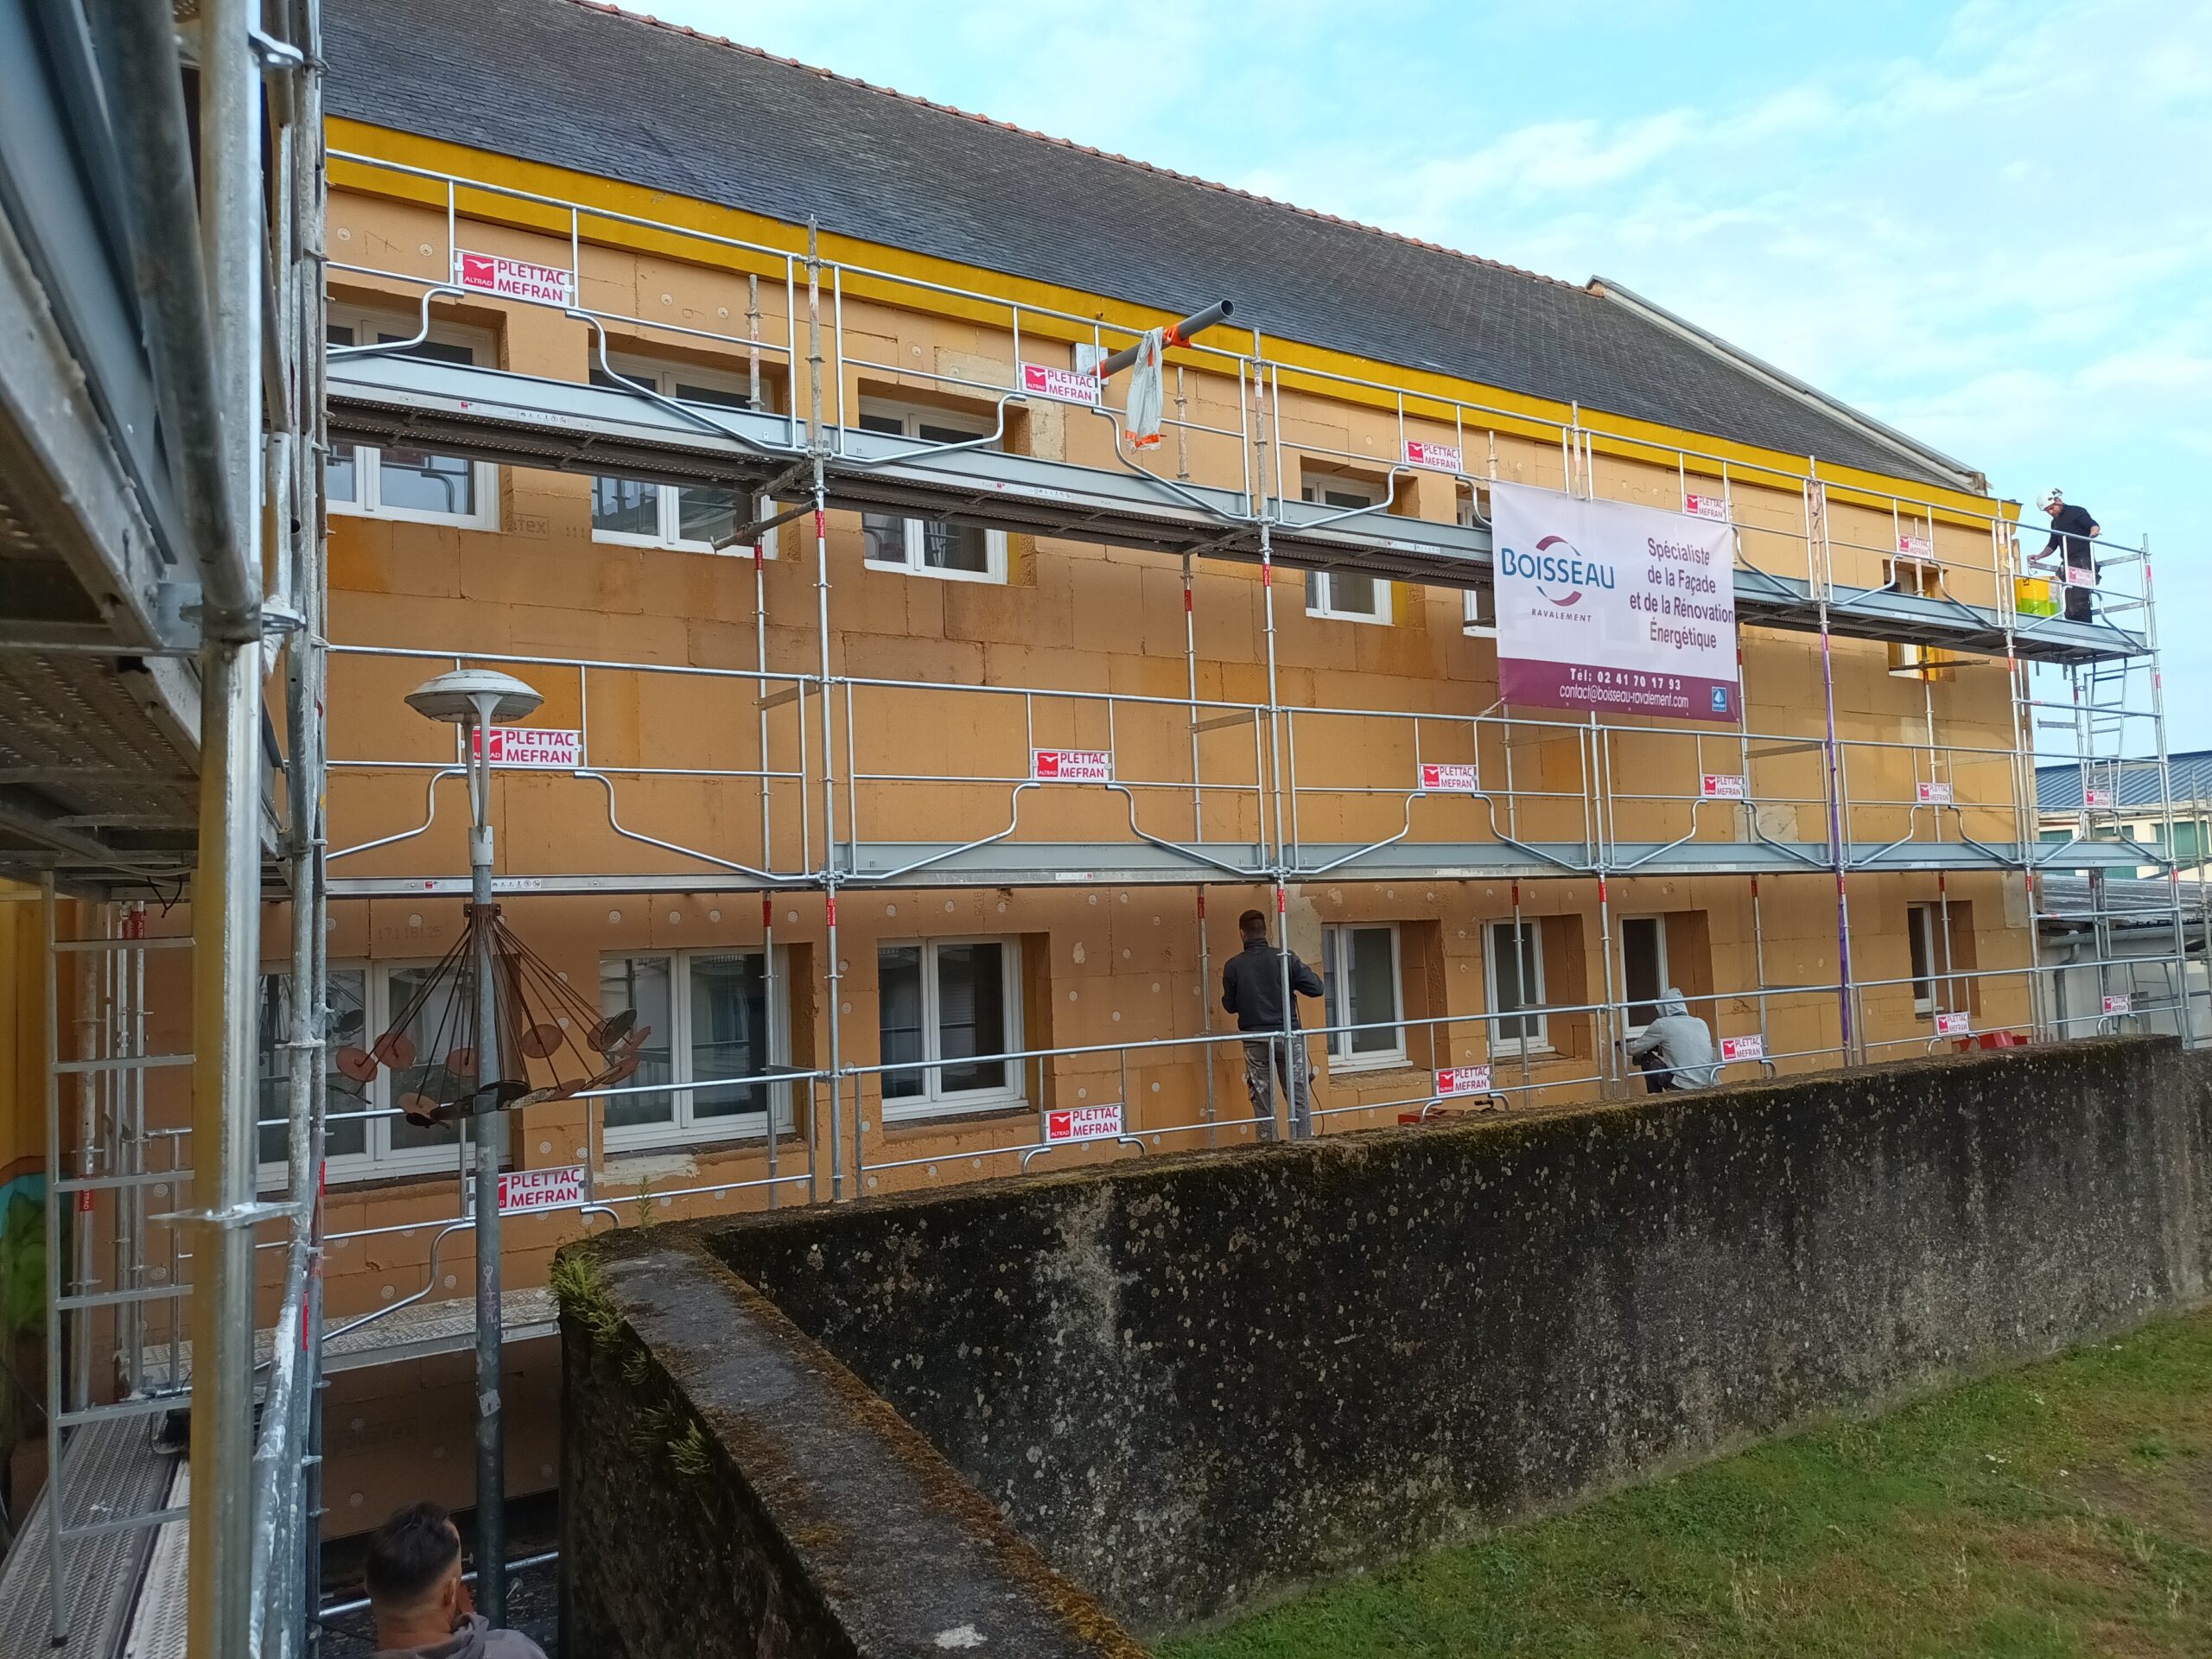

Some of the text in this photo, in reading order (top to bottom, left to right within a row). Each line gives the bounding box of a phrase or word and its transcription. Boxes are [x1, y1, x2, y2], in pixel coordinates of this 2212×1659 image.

[498, 260, 565, 286] PLETTAC
[464, 276, 493, 287] ALTRAD
[498, 278, 563, 302] MEFRAN
[1047, 370, 1092, 388] PLETTAC
[1049, 384, 1091, 401] MEFRAN
[1424, 444, 1456, 459] PLETTAC
[1425, 456, 1456, 469] MEFRAN
[1699, 496, 1724, 508] PLETTAC
[1699, 508, 1723, 518] MEFRAN
[1648, 537, 1710, 566] Spécialiste
[1502, 548, 1615, 589] BOISSEAU
[1648, 565, 1716, 595] de la Façade
[1531, 608, 1592, 622] RAVALEMENT
[1630, 592, 1734, 624] et de la Rénovation
[1650, 617, 1717, 651] Énergétique
[1598, 671, 1611, 683] 02
[1616, 673, 1628, 685] 41
[1634, 675, 1646, 687] 70
[1651, 677, 1663, 690] 17
[1669, 678, 1681, 690] 93
[1559, 683, 1689, 709] contact@boisseau-ravalement.com
[506, 731, 574, 747] PLETTAC
[506, 749, 572, 763] MEFRAN
[1060, 753, 1105, 764] PLETTAC
[1060, 767, 1103, 778] MEFRAN
[1440, 766, 1472, 776] PLETTAC
[1441, 779, 1471, 788] MEFRAN
[1717, 777, 1742, 785] PLETTAC
[1735, 1037, 1760, 1047] PLETTAC
[1737, 1048, 1760, 1058] MEFRAN
[1455, 1066, 1487, 1079] PLETTAC
[1455, 1079, 1486, 1091] MEFRAN
[1073, 1107, 1118, 1122] PLETTAC
[1073, 1122, 1116, 1136] MEFRAN
[511, 1168, 580, 1190] PLETTAC
[511, 1187, 577, 1207] MEFRAN
